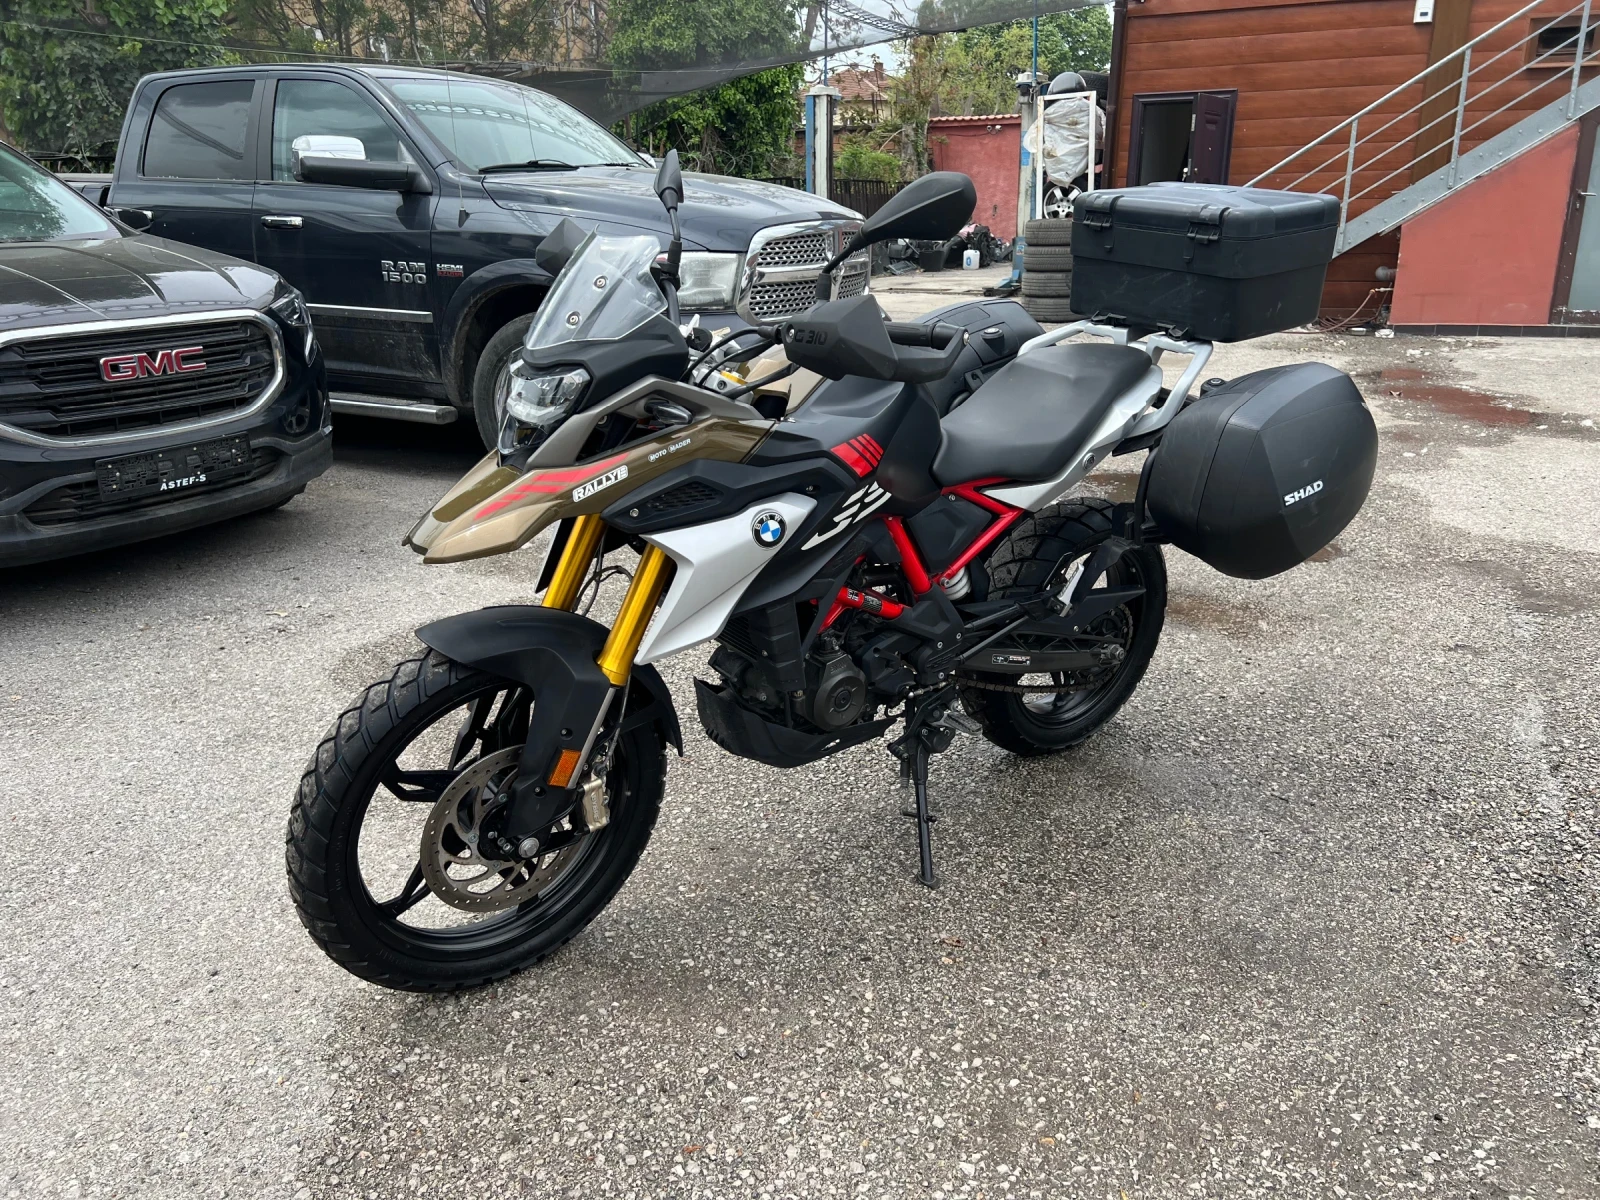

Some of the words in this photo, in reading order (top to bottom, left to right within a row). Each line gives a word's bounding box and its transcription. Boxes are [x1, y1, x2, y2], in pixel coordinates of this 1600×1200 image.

[381, 260, 426, 273] RAM
[436, 263, 464, 272] HEMI
[382, 271, 427, 284] 1500
[806, 330, 829, 346] 310
[100, 346, 207, 382] GMC
[648, 449, 667, 463] MOTO
[668, 438, 692, 454] MADER
[160, 474, 207, 491] ASTEF-S
[572, 465, 629, 502] RALLYE
[1284, 480, 1324, 506] SHAD
[754, 513, 783, 531] BMW
